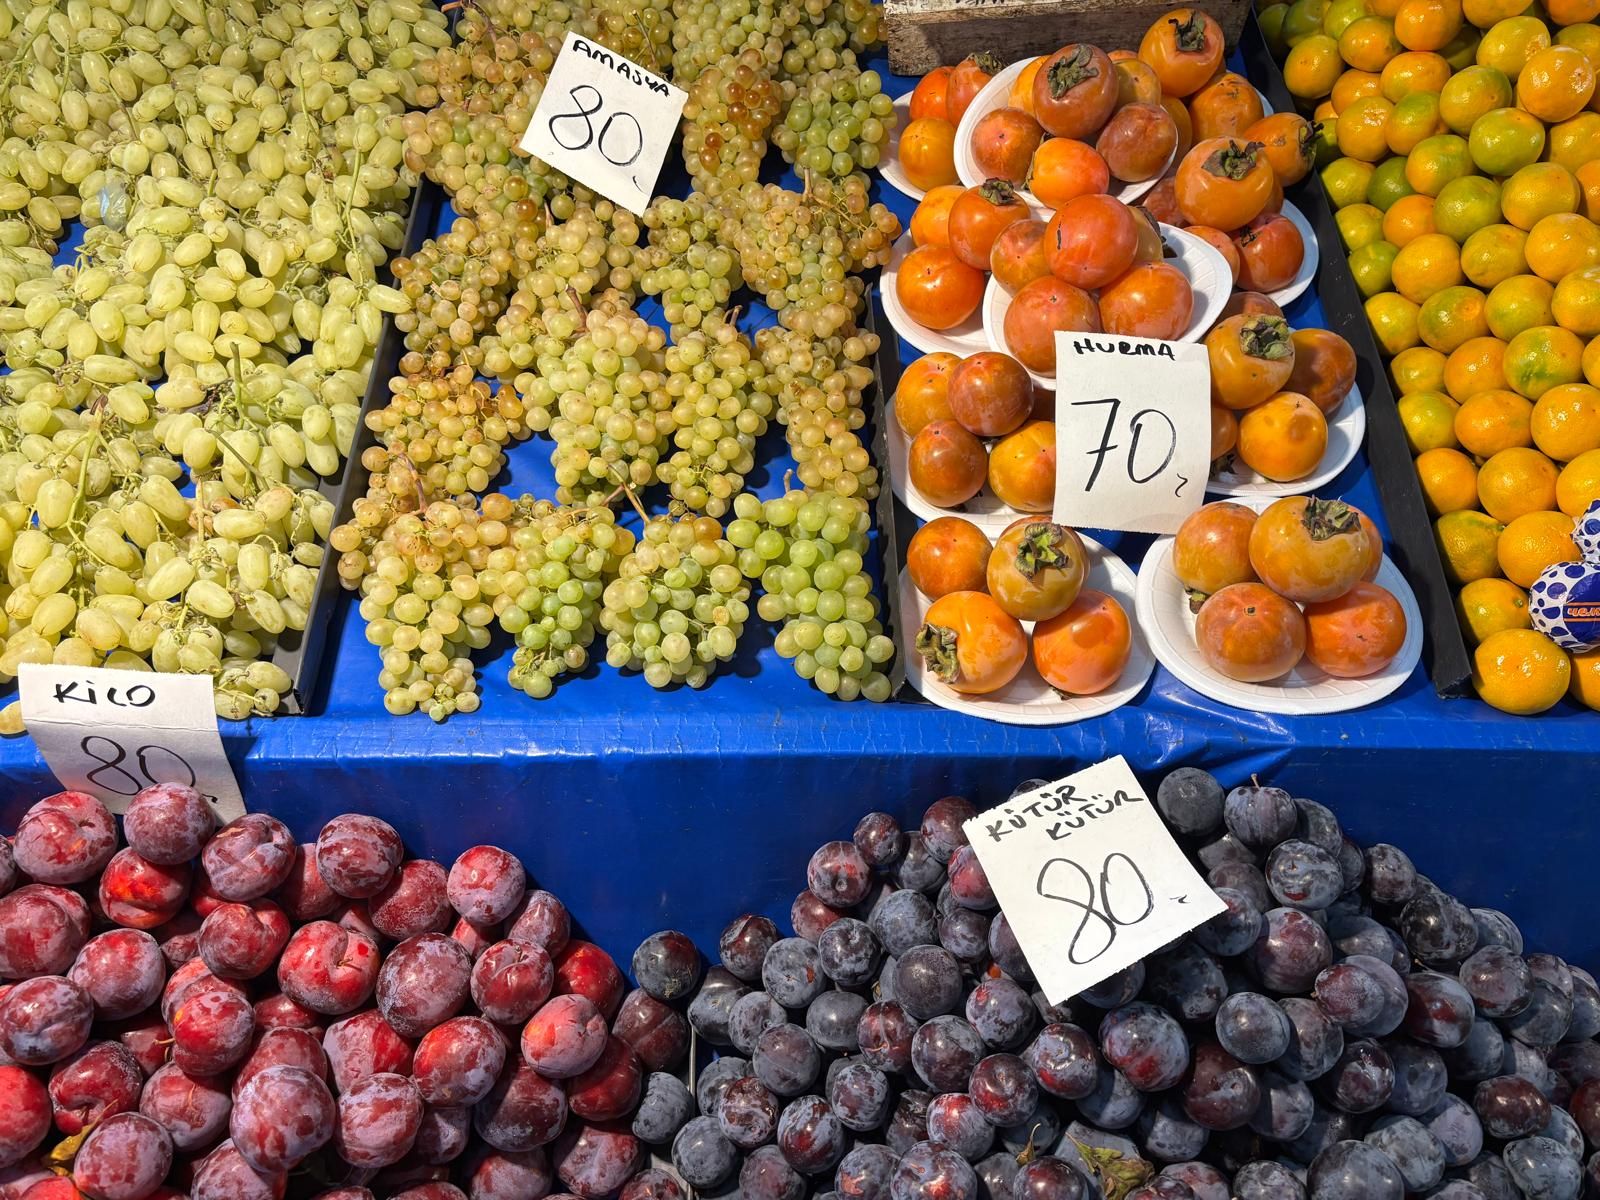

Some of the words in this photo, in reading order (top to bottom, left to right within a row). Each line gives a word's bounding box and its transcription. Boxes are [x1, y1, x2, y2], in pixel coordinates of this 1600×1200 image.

[572, 39, 670, 97] AMASYA
[1073, 338, 1176, 361] HURMA
[985, 785, 1089, 842] KÜTÜR
[1046, 790, 1145, 841] KÜTÜR
